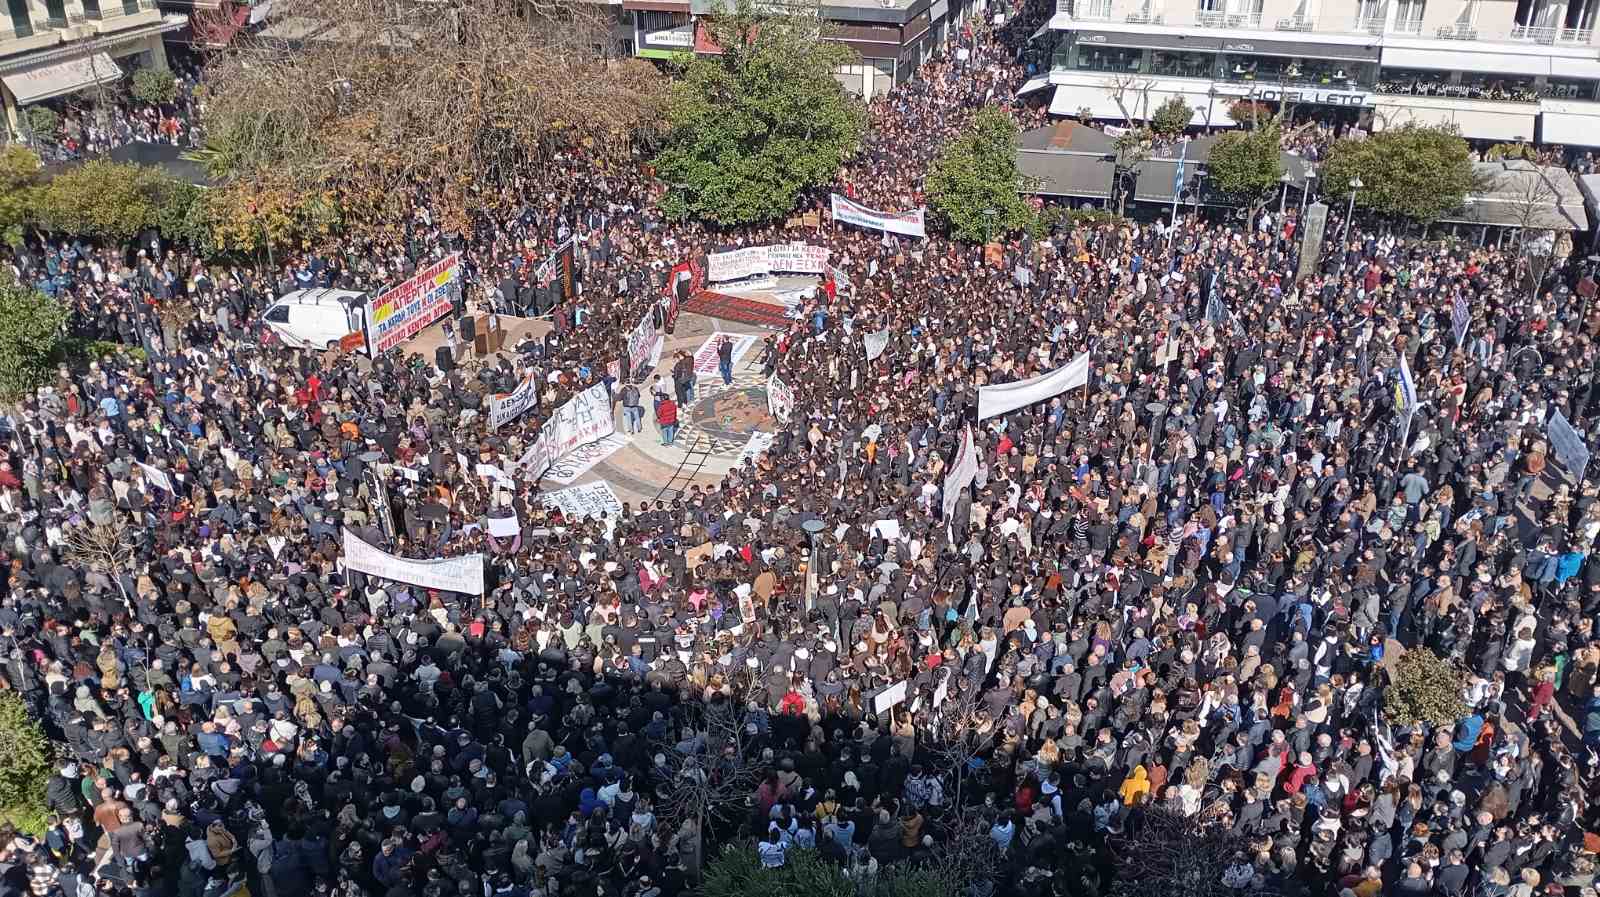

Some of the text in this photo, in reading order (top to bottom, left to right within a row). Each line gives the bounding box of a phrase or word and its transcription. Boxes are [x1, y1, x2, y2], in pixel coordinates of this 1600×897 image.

[1249, 87, 1366, 106] HOTEL LETO
[393, 279, 436, 312] ΑΠΕΡΓΙΑ
